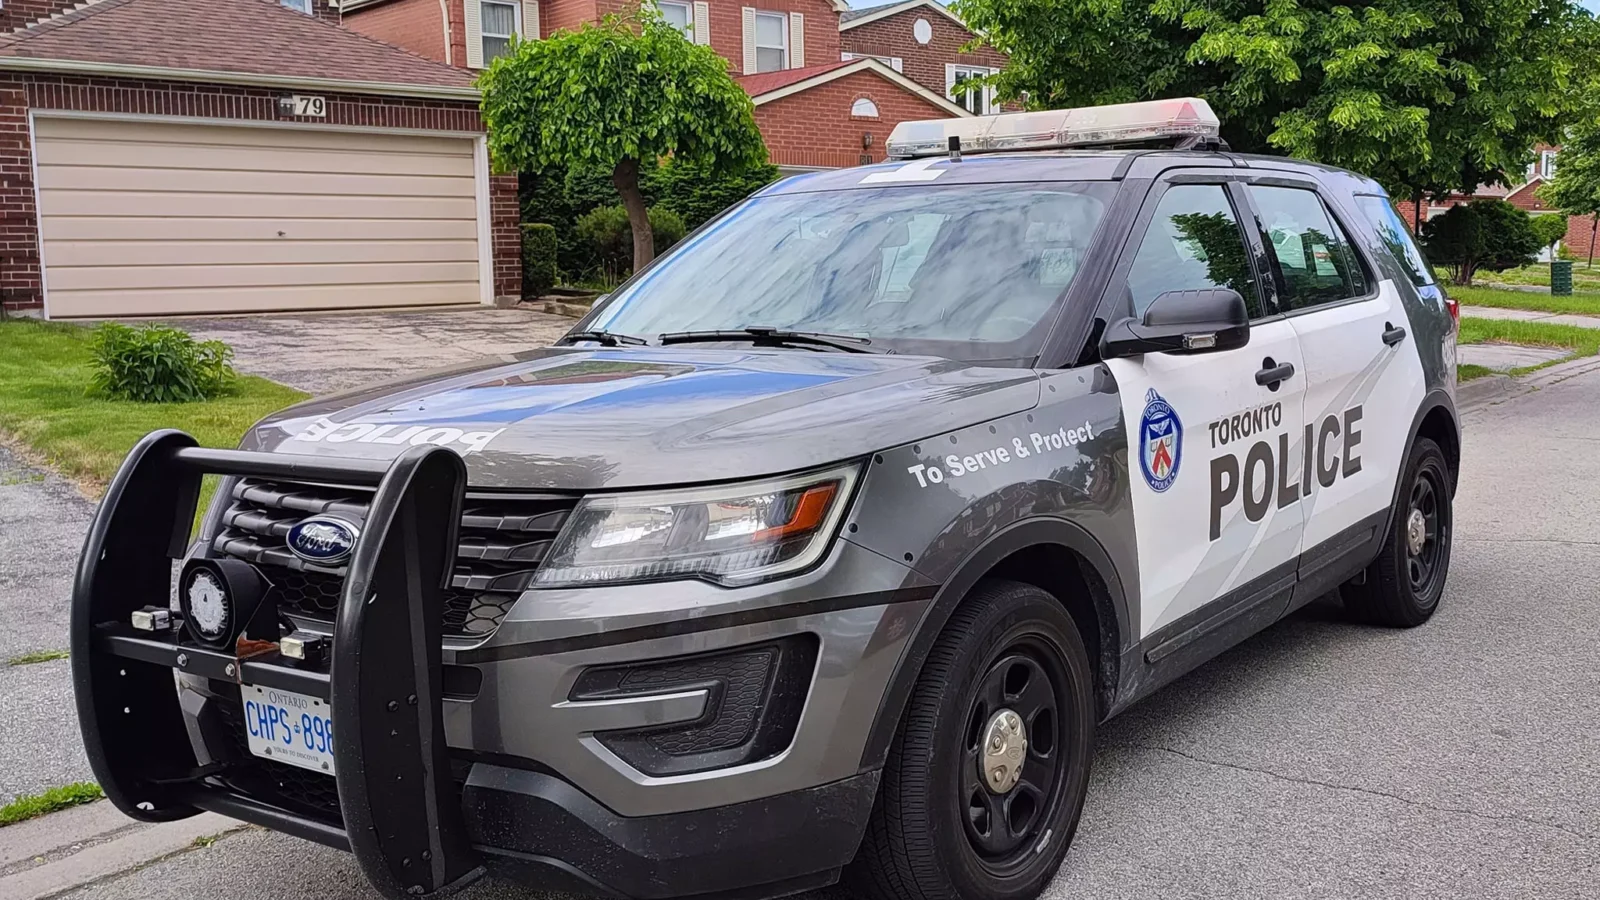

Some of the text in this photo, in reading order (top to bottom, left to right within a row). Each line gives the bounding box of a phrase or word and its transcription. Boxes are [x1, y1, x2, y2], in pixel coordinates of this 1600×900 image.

[300, 97, 323, 115] 79
[1145, 403, 1171, 420] TORONTO
[1208, 401, 1282, 449] TORONTO
[907, 420, 1095, 489] To Serve & Protect
[1153, 476, 1173, 491] POLICE
[1209, 404, 1363, 542] POLICE
[296, 522, 340, 552] Ford
[268, 690, 308, 710] ONTARIO
[246, 700, 292, 745] CHPS
[273, 746, 319, 762] YOURS TO DISCOVER
